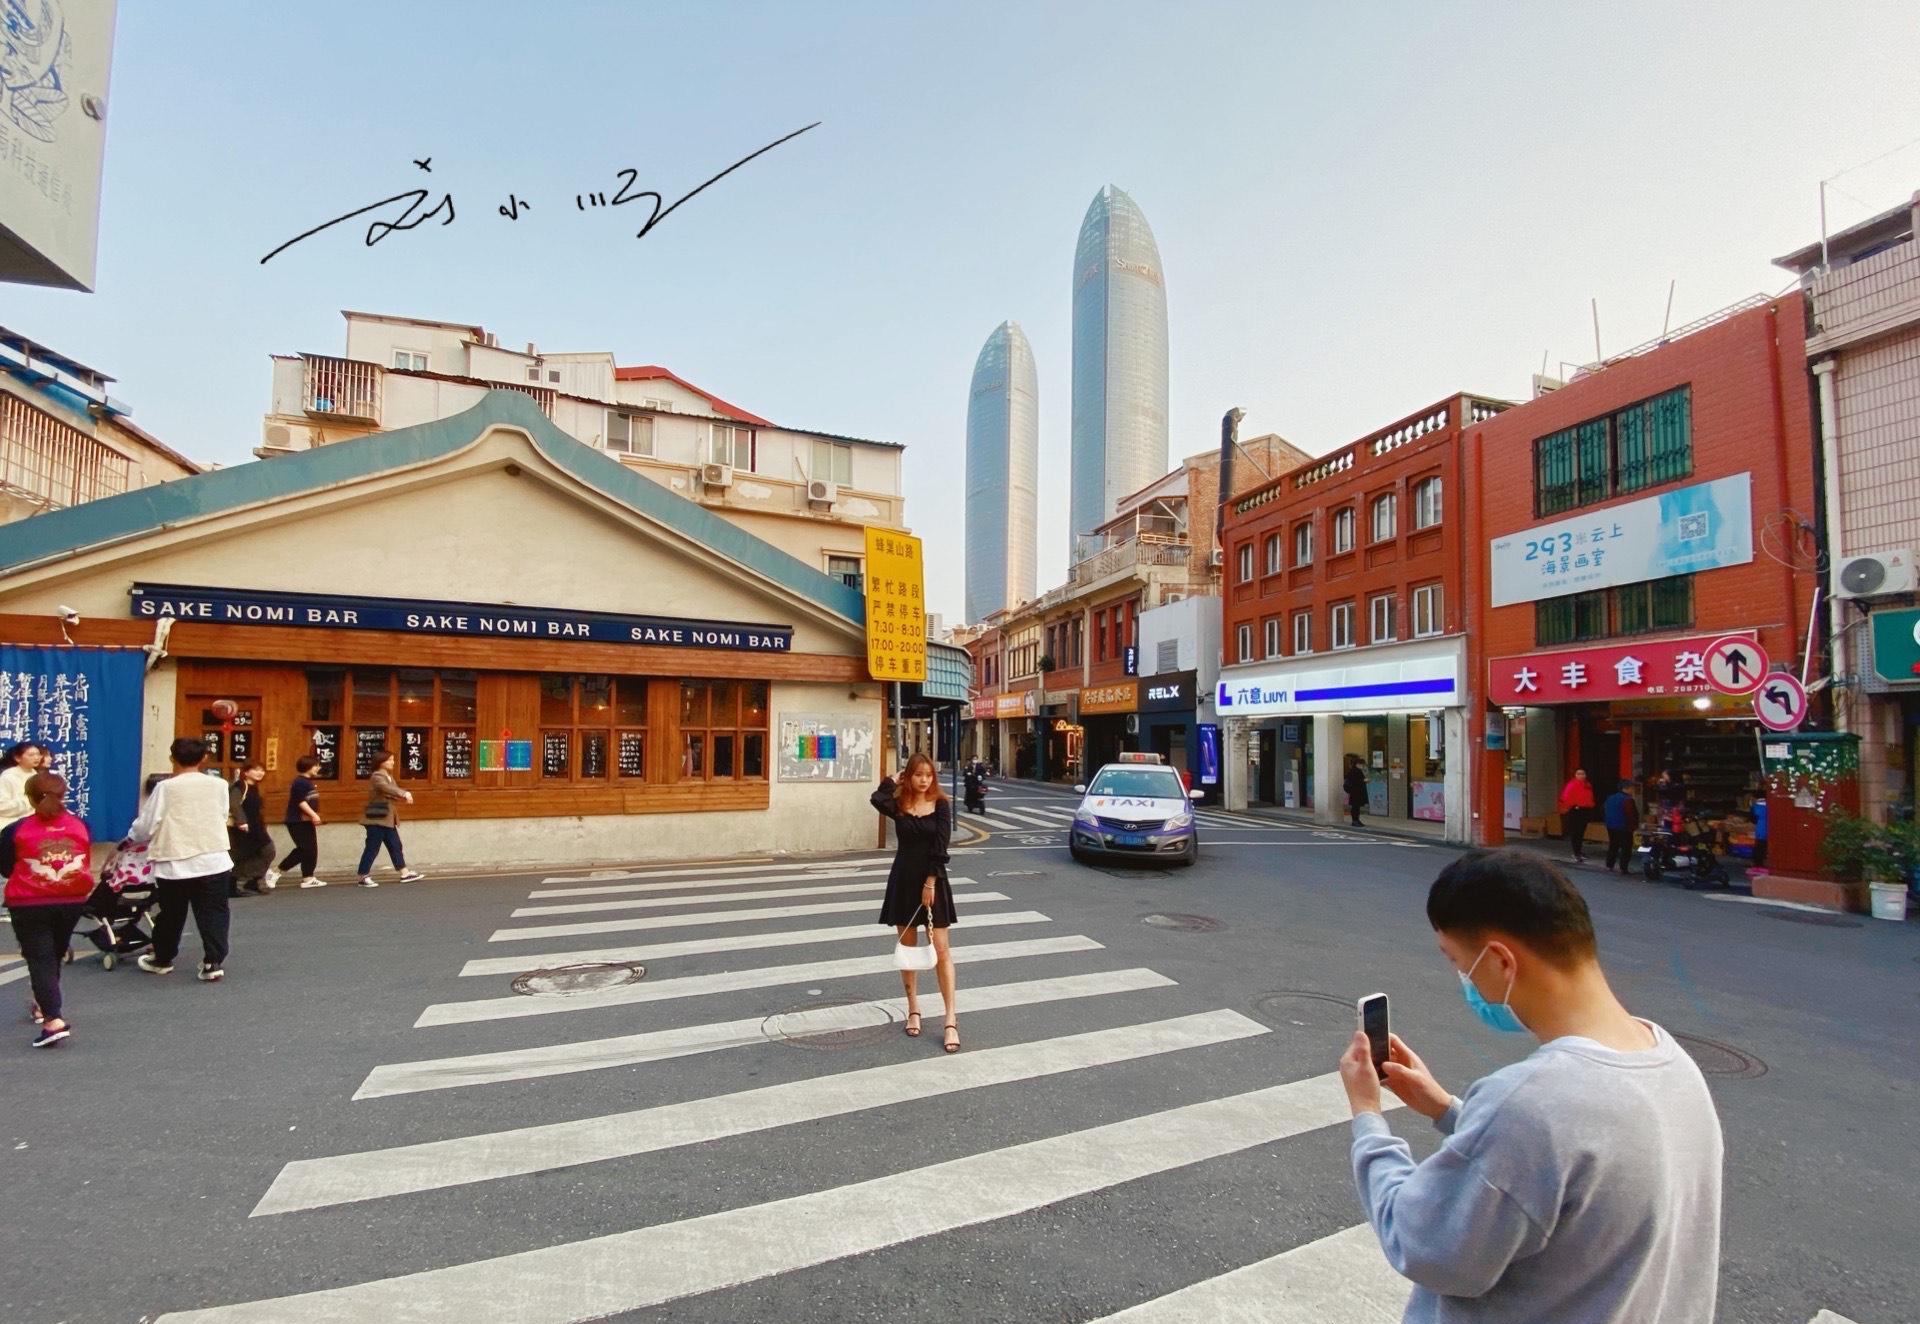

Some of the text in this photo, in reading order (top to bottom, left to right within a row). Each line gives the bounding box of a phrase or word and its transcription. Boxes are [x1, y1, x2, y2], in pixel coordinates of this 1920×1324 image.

[876, 537, 914, 559] 蜂巢山路
[1541, 548, 1605, 575] 海景画室
[872, 576, 920, 599] 繁忙路段
[141, 600, 358, 624] SAKE NOMI BAR
[872, 600, 921, 621] 严禁停车
[406, 614, 590, 636] SAKE NOMI BAR
[631, 627, 784, 648] SAKE NOMI BAR
[875, 655, 922, 675] 停车重罚
[1513, 651, 1706, 693] 大丰食杂
[1148, 685, 1180, 700] RELX
[1238, 687, 1288, 705] 六意 LIUYI
[406, 732, 423, 771] 到天光
[1108, 798, 1155, 808] TAXI
